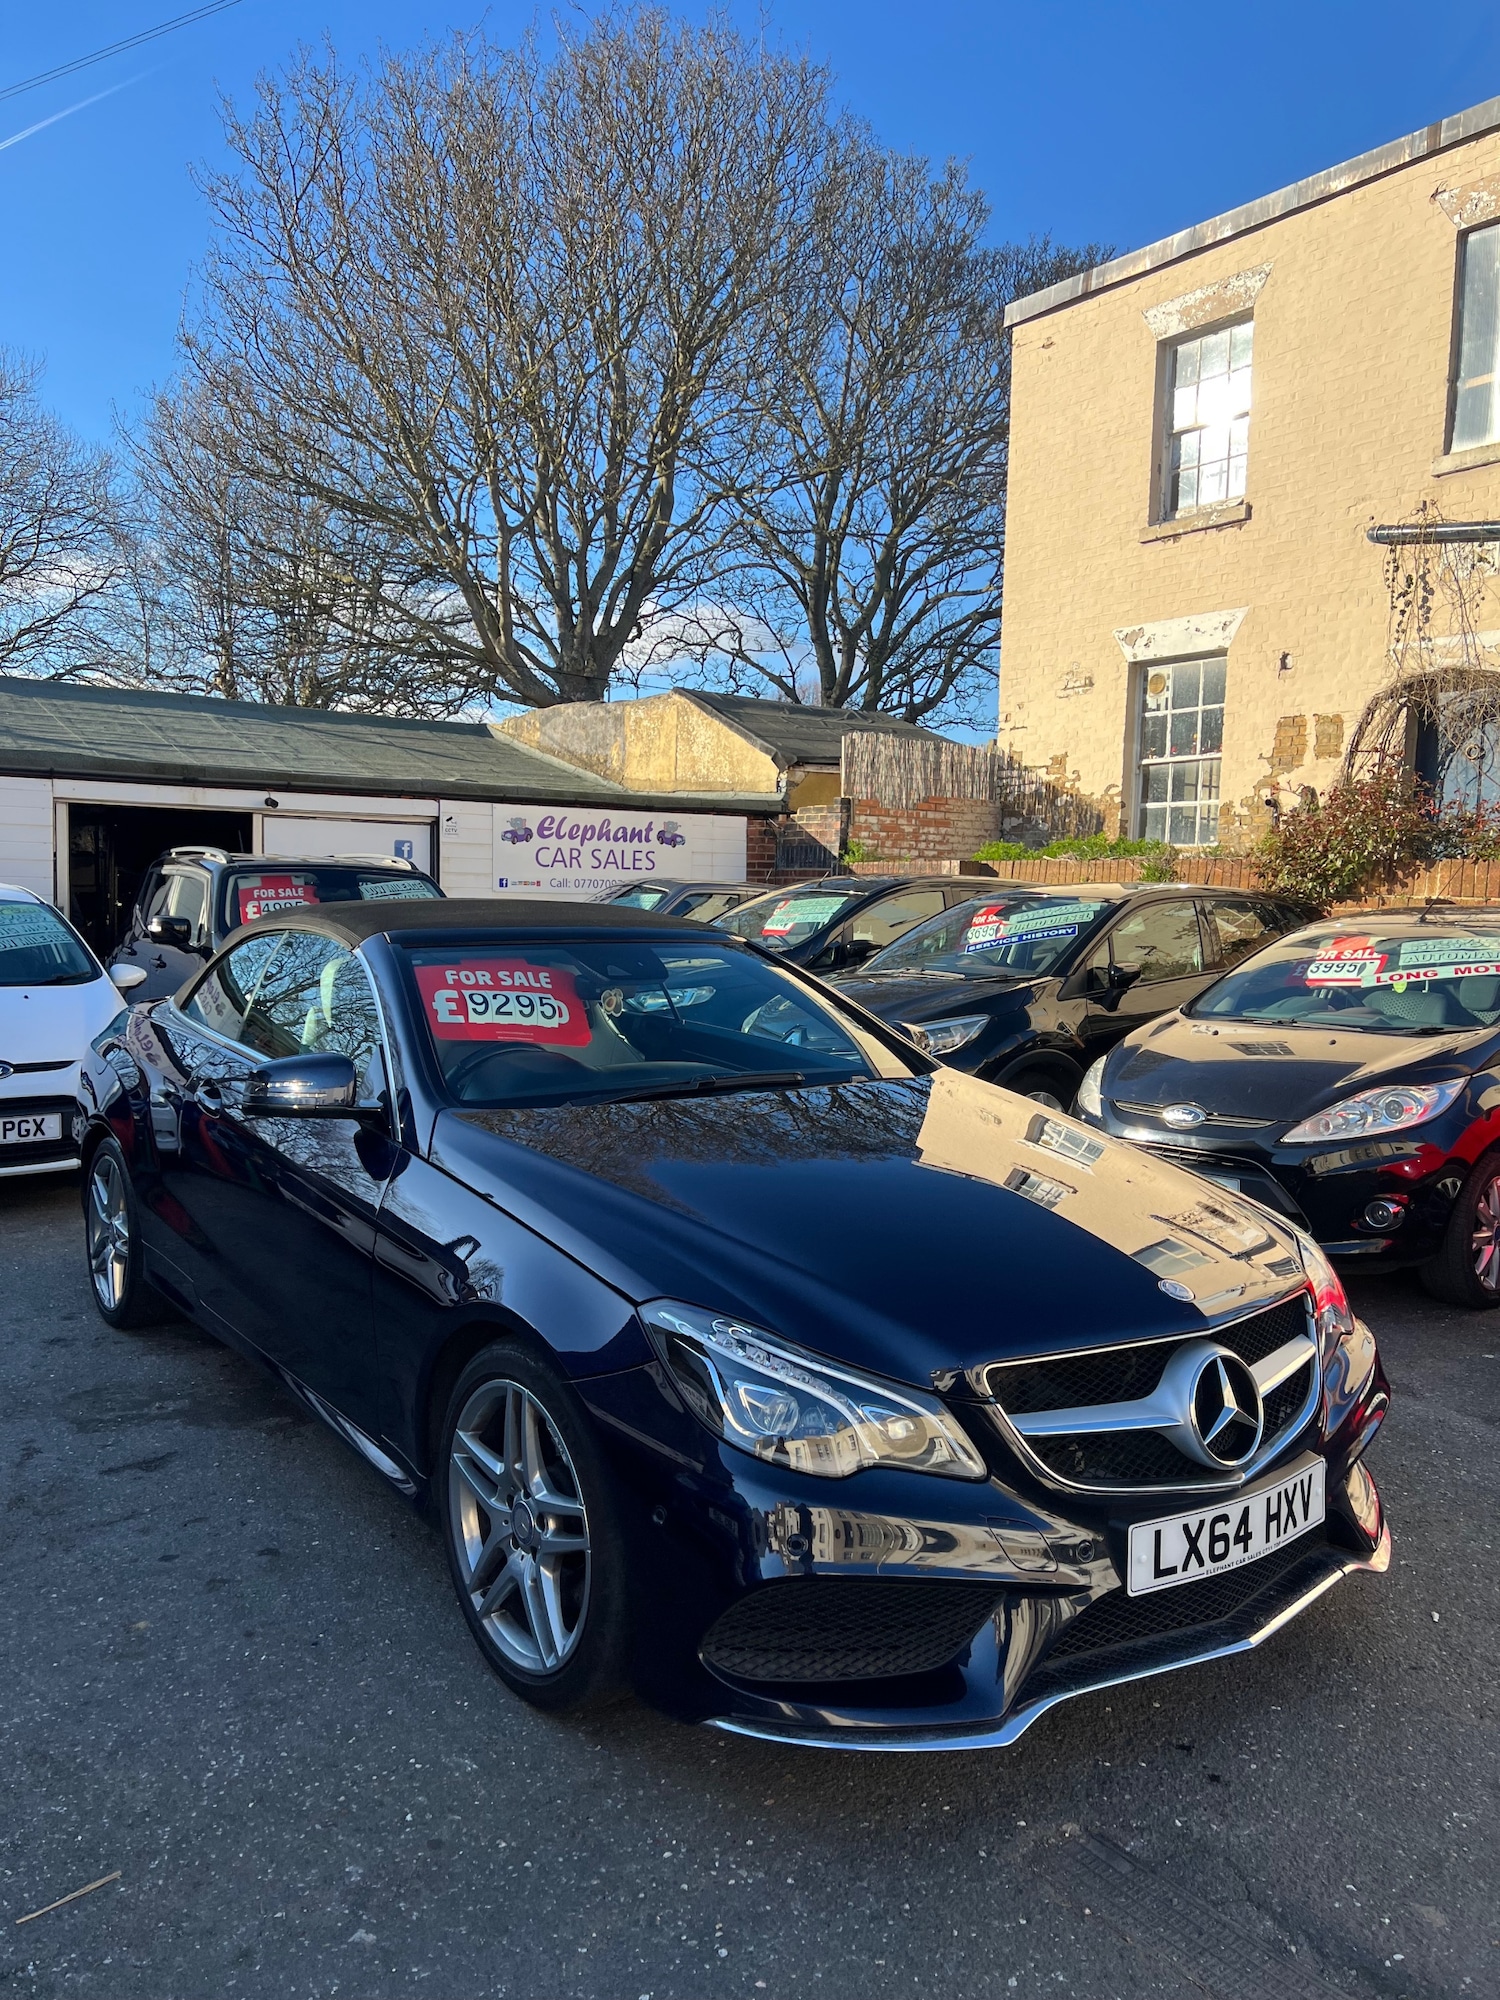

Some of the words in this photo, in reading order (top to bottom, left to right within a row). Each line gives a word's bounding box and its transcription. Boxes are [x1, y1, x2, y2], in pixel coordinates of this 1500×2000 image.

[537, 815, 653, 847] Elephant
[535, 846, 582, 869] CAR
[591, 848, 656, 871] SALES
[253, 889, 276, 898] FOR
[278, 888, 304, 897] SALE
[550, 878, 571, 888] Call:
[574, 879, 625, 889] 077070
[972, 915, 987, 924] FOR
[1048, 913, 1091, 925] DIESEL
[967, 925, 997, 940] 3695
[968, 937, 1020, 951] SERVICE
[1022, 927, 1074, 940] HISTORY
[445, 970, 494, 985] FOR
[497, 971, 552, 989] SALE
[1376, 969, 1438, 984] LONG
[1454, 964, 1500, 975] MOT
[2, 1117, 46, 1140] PGX
[1153, 1505, 1253, 1580] LX64
[1265, 1473, 1313, 1544] HXV
[1206, 1561, 1234, 1575] ELEPHANT
[1235, 1558, 1246, 1566] CAR
[1247, 1551, 1262, 1561] SALES
